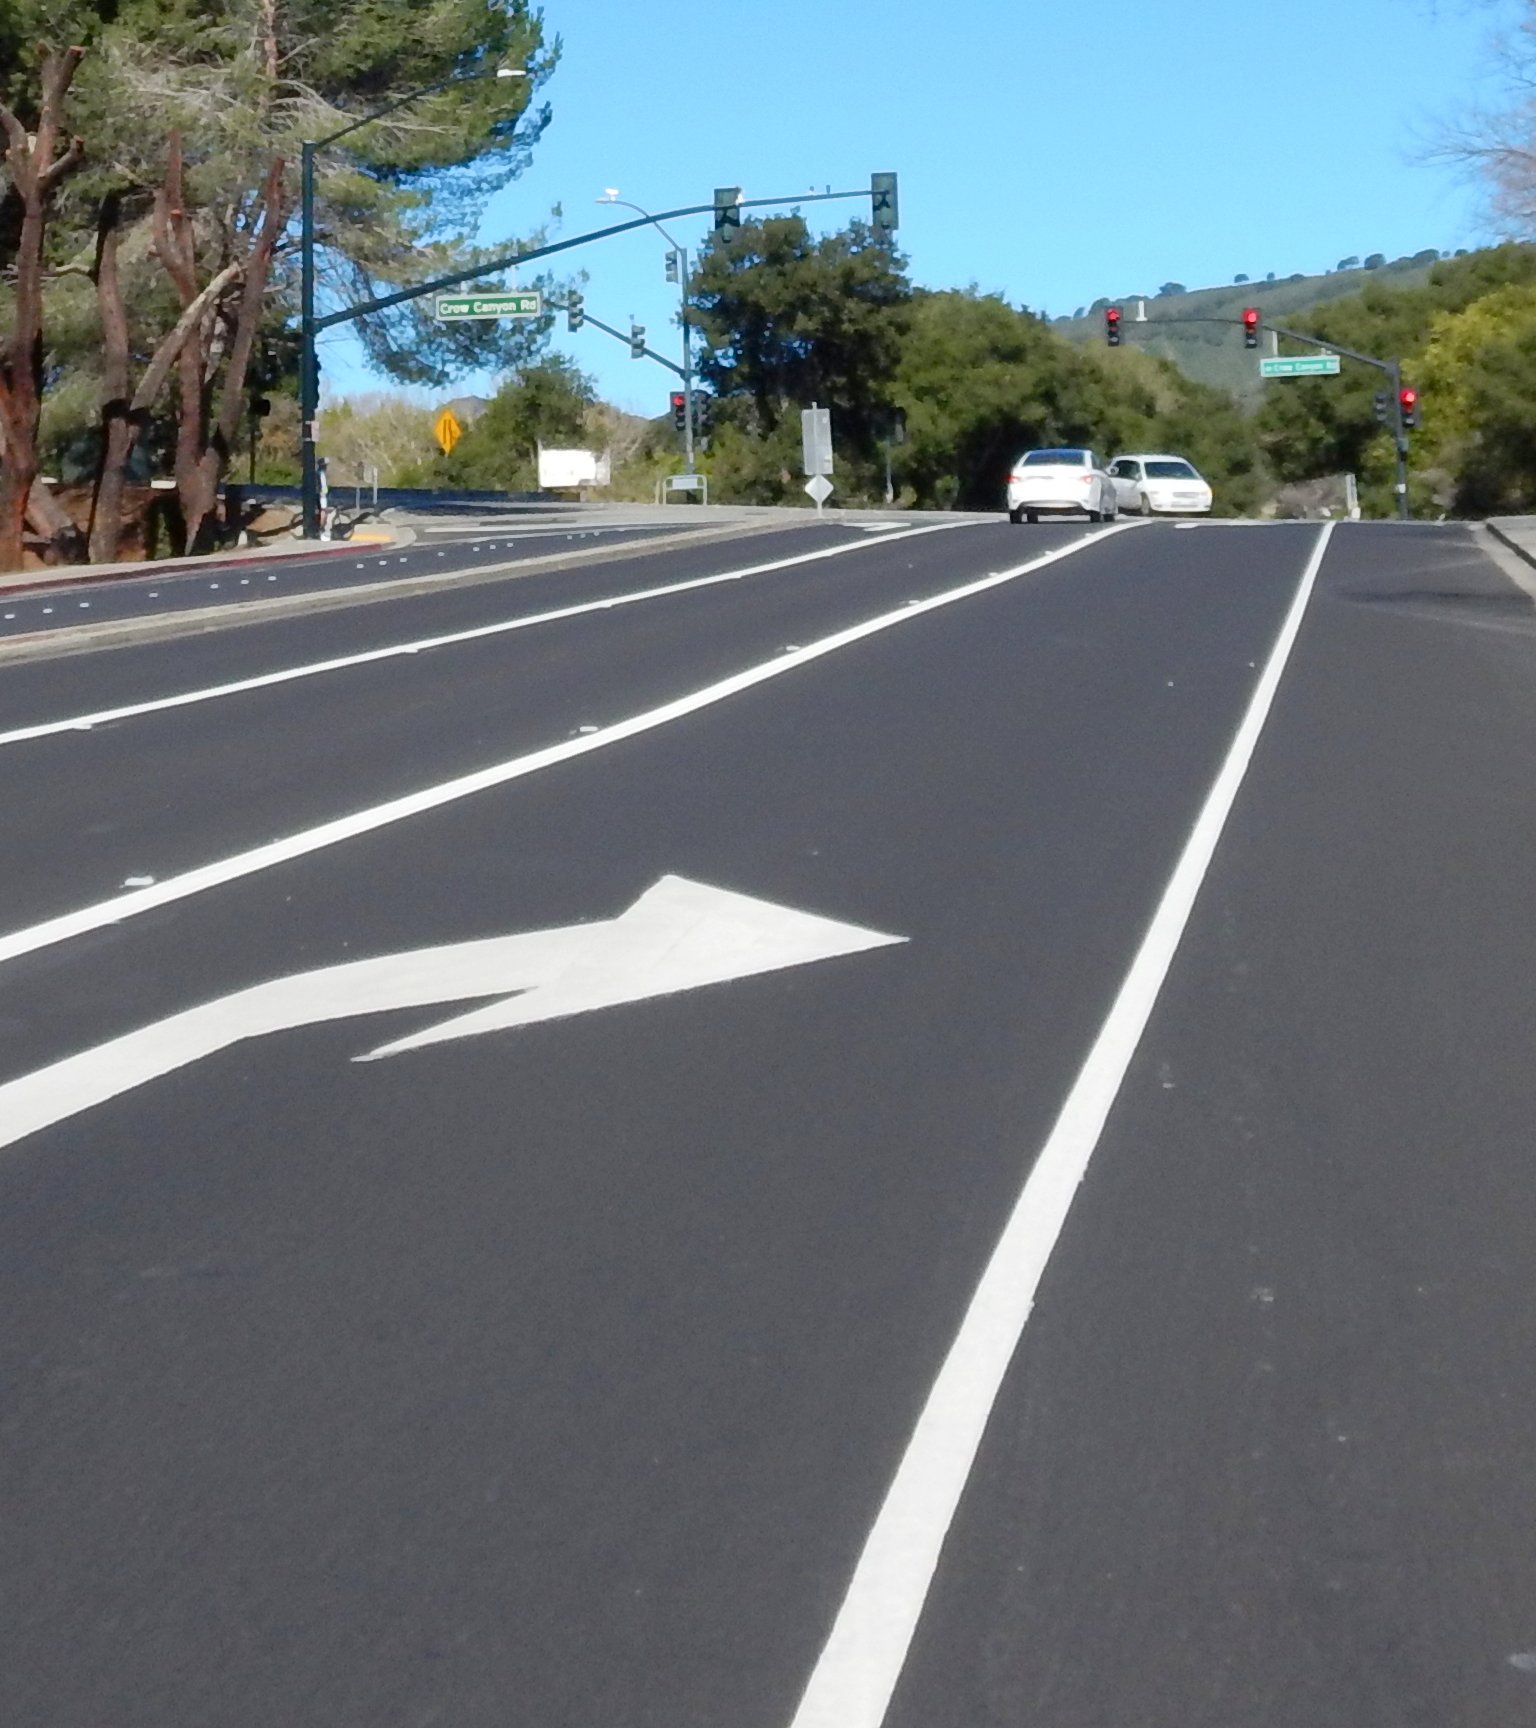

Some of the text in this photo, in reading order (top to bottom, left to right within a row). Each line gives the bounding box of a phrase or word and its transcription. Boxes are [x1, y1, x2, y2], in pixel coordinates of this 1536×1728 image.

[440, 299, 537, 315] Crow Canyon Rd
